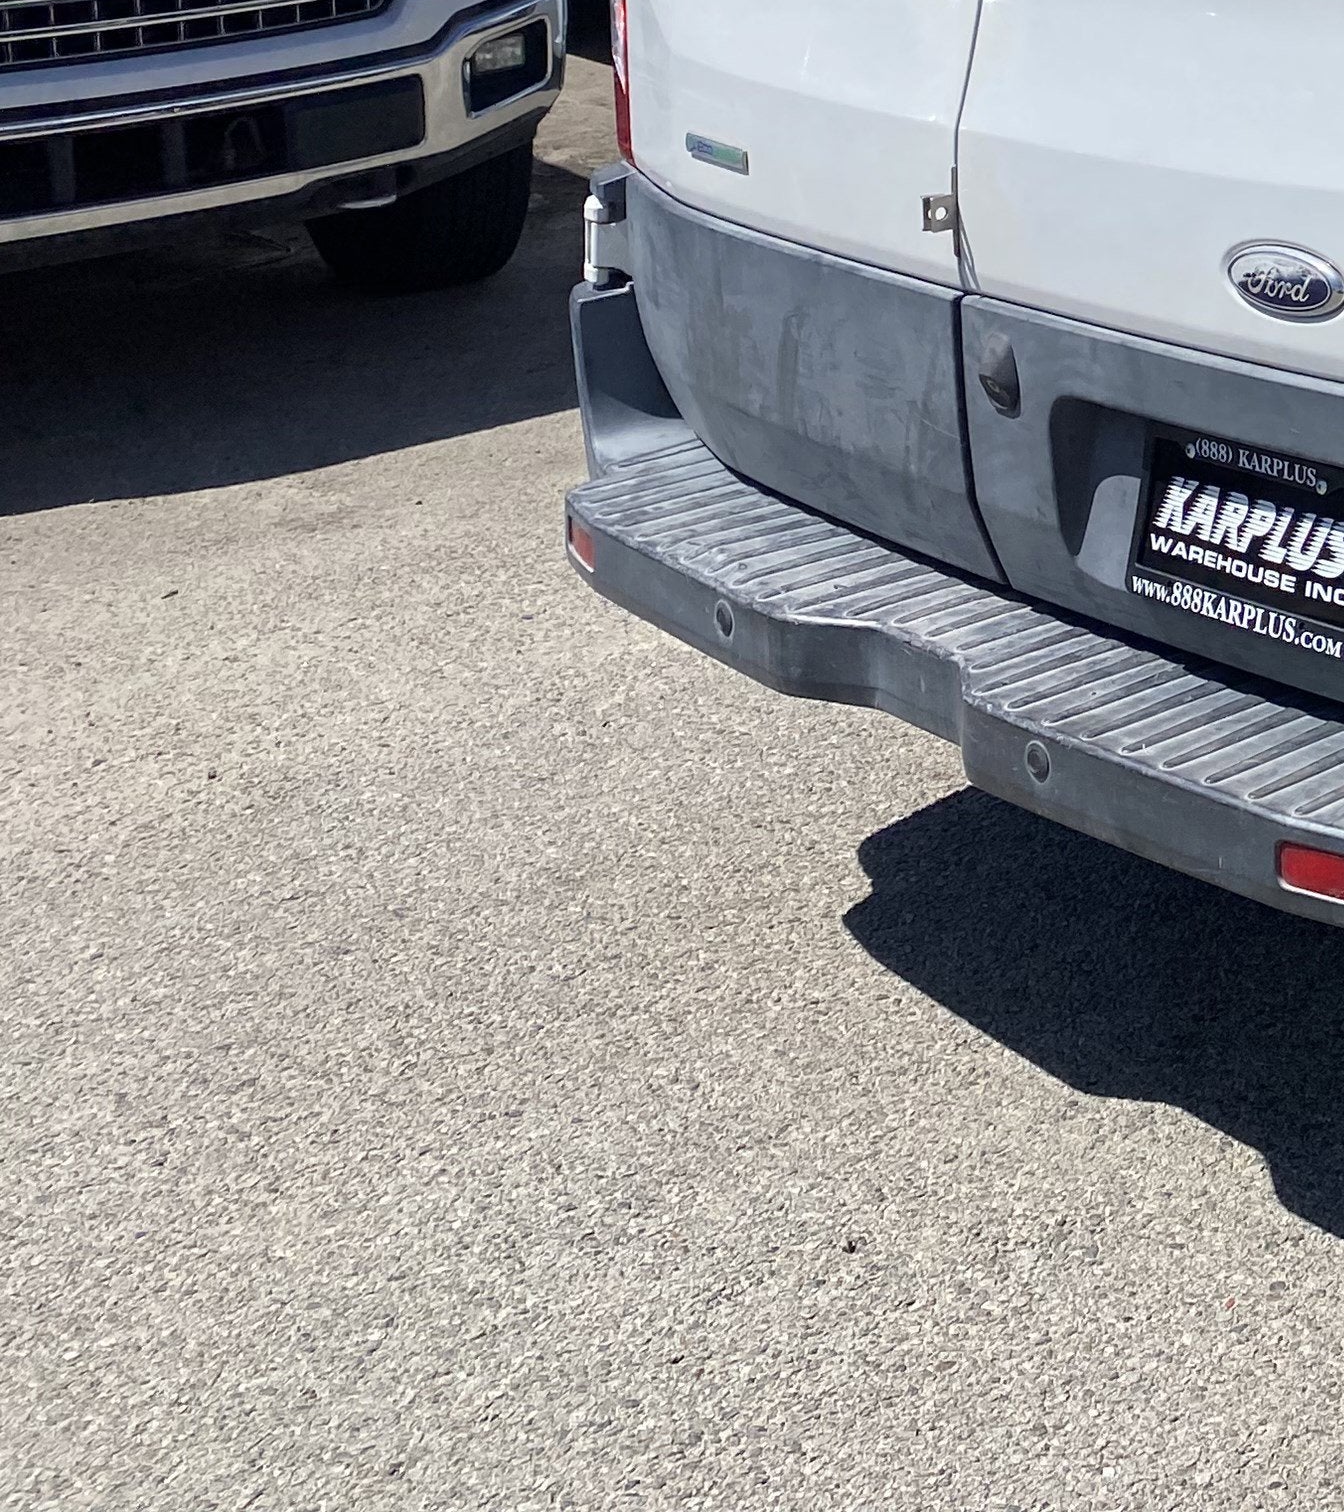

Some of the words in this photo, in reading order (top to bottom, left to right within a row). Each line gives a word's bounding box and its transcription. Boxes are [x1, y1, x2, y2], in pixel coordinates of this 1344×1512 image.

[1243, 264, 1313, 303] Ford
[1195, 438, 1233, 464] (888)
[1238, 449, 1317, 487] KARPLUS
[1150, 533, 1296, 594] WAREHOUSE
